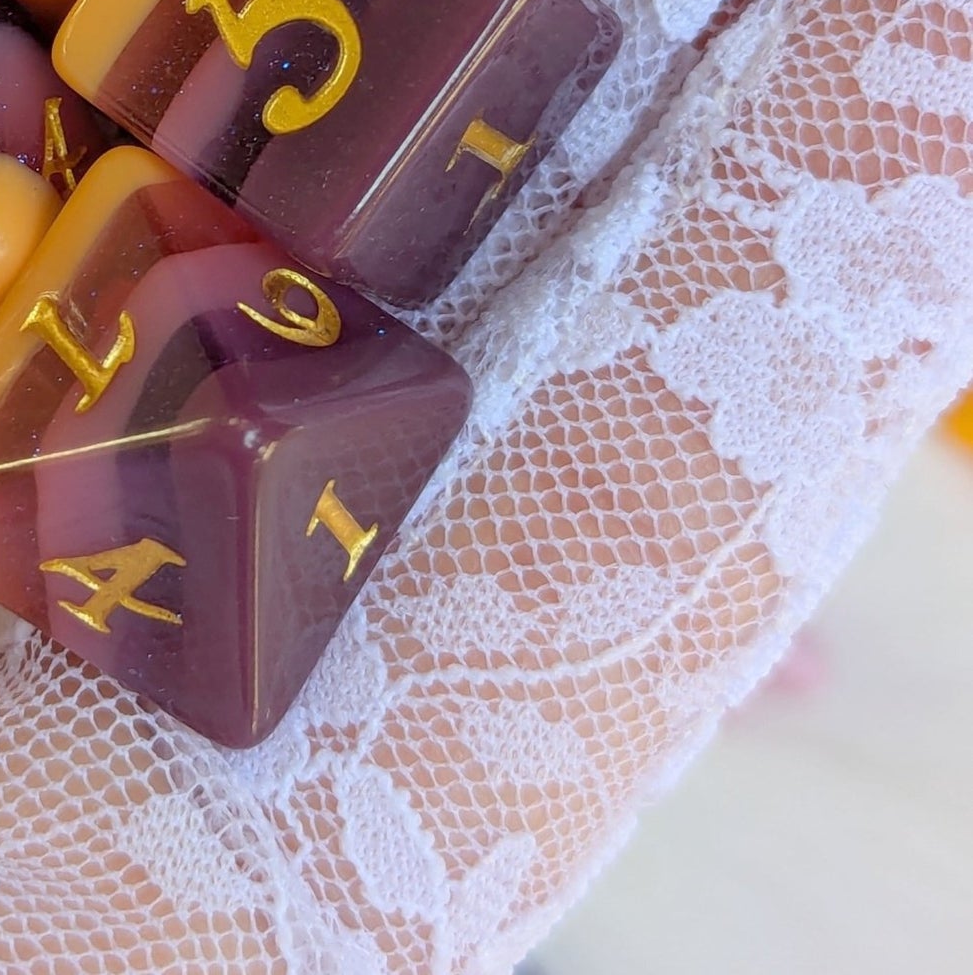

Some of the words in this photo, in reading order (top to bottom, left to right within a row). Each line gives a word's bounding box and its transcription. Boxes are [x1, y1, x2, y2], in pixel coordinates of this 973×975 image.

[445, 108, 535, 235] 1
[305, 479, 379, 583] 1
[39, 537, 187, 633] 4
